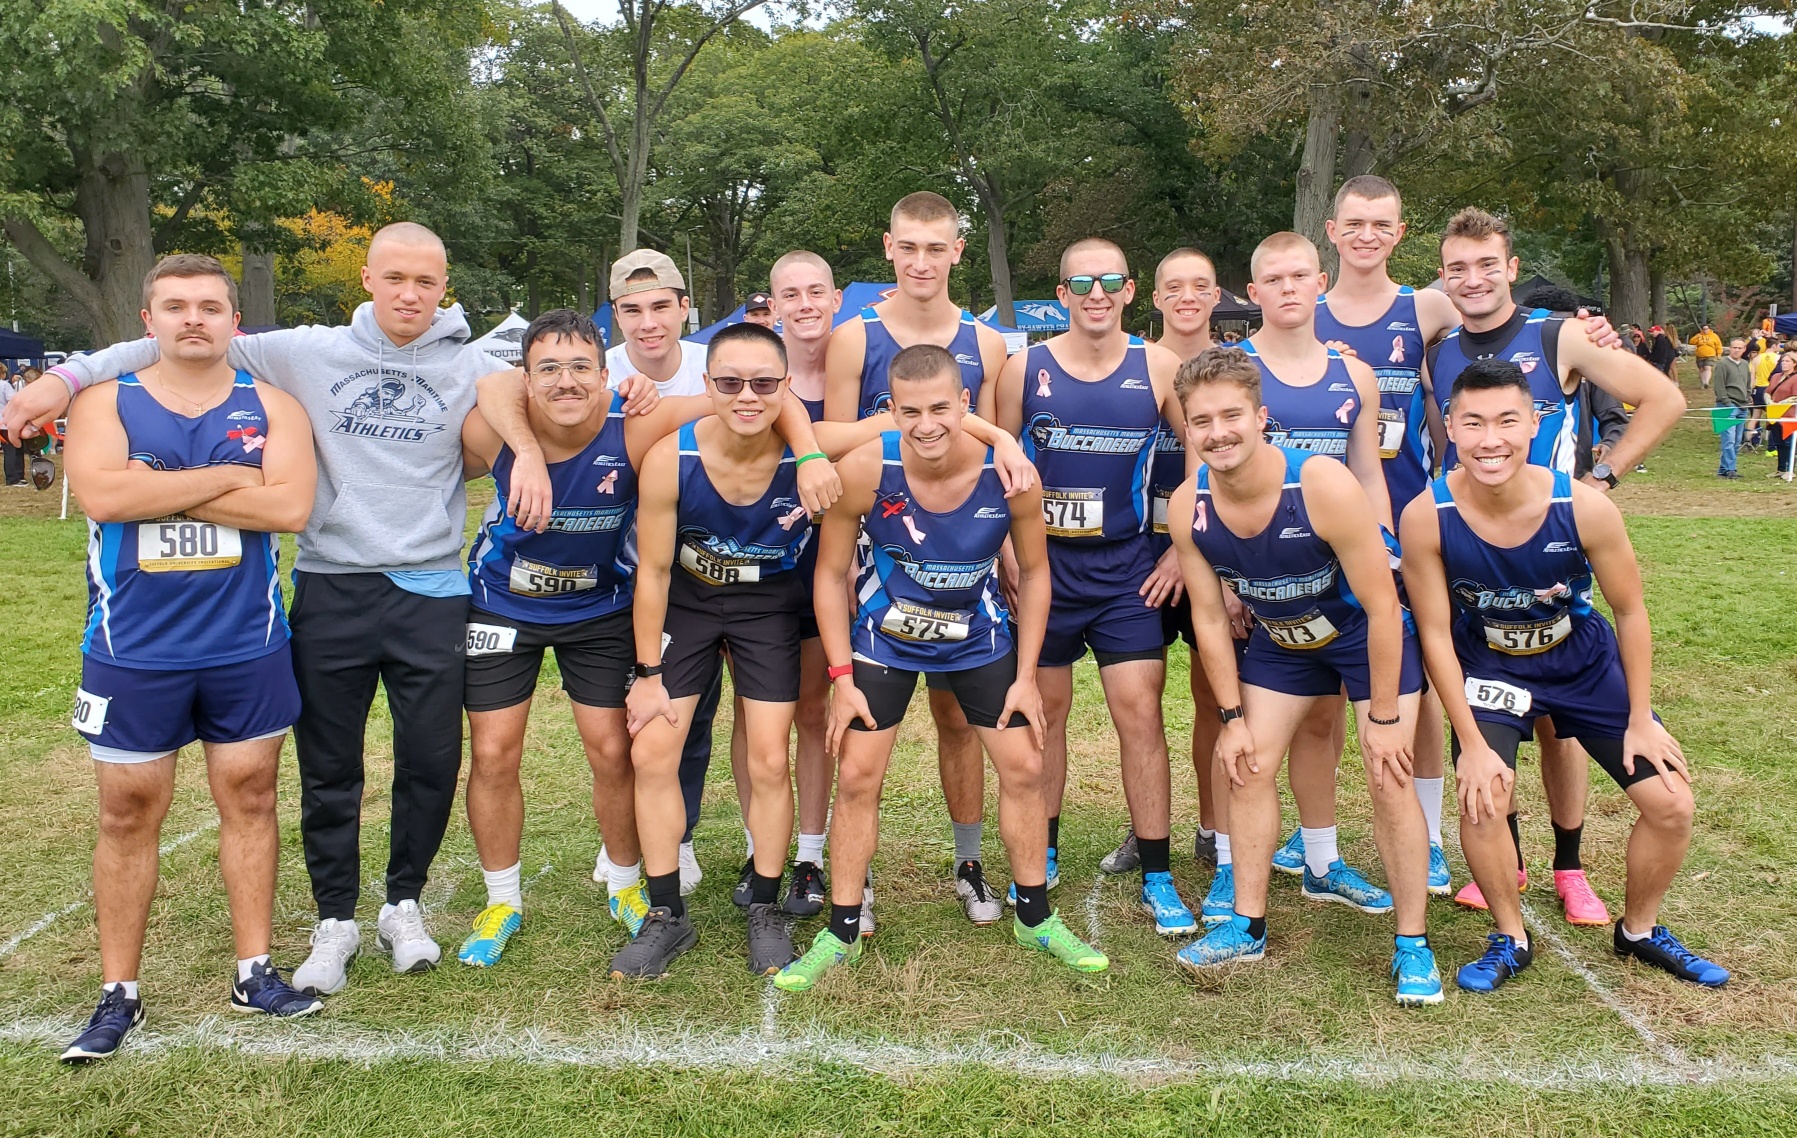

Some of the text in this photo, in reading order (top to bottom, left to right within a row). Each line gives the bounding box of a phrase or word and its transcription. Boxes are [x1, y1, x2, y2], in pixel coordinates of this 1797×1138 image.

[329, 368, 449, 413] MASSACHUSETTS MARITIME
[335, 415, 424, 441] ATHLETICS
[1047, 427, 1146, 453] BUCCANEERS
[1042, 490, 1088, 500] SUFFOLK INVITE
[546, 514, 625, 532] CANEERS
[1043, 500, 1087, 528] 574
[160, 524, 218, 558] 580
[528, 563, 581, 578] SUFFOLK INVITE
[695, 555, 741, 584] 588
[925, 564, 975, 572] MASSACHUSETTS
[528, 573, 576, 592] 590
[1236, 572, 1334, 600] BUCCANEERS
[903, 604, 955, 621] SUFFOLK INVITE
[467, 630, 500, 650] 590
[900, 615, 949, 640] 575
[1269, 625, 1317, 644] 573
[1503, 627, 1554, 648] 576
[1477, 684, 1517, 710] 576
[74, 697, 91, 723] 80
